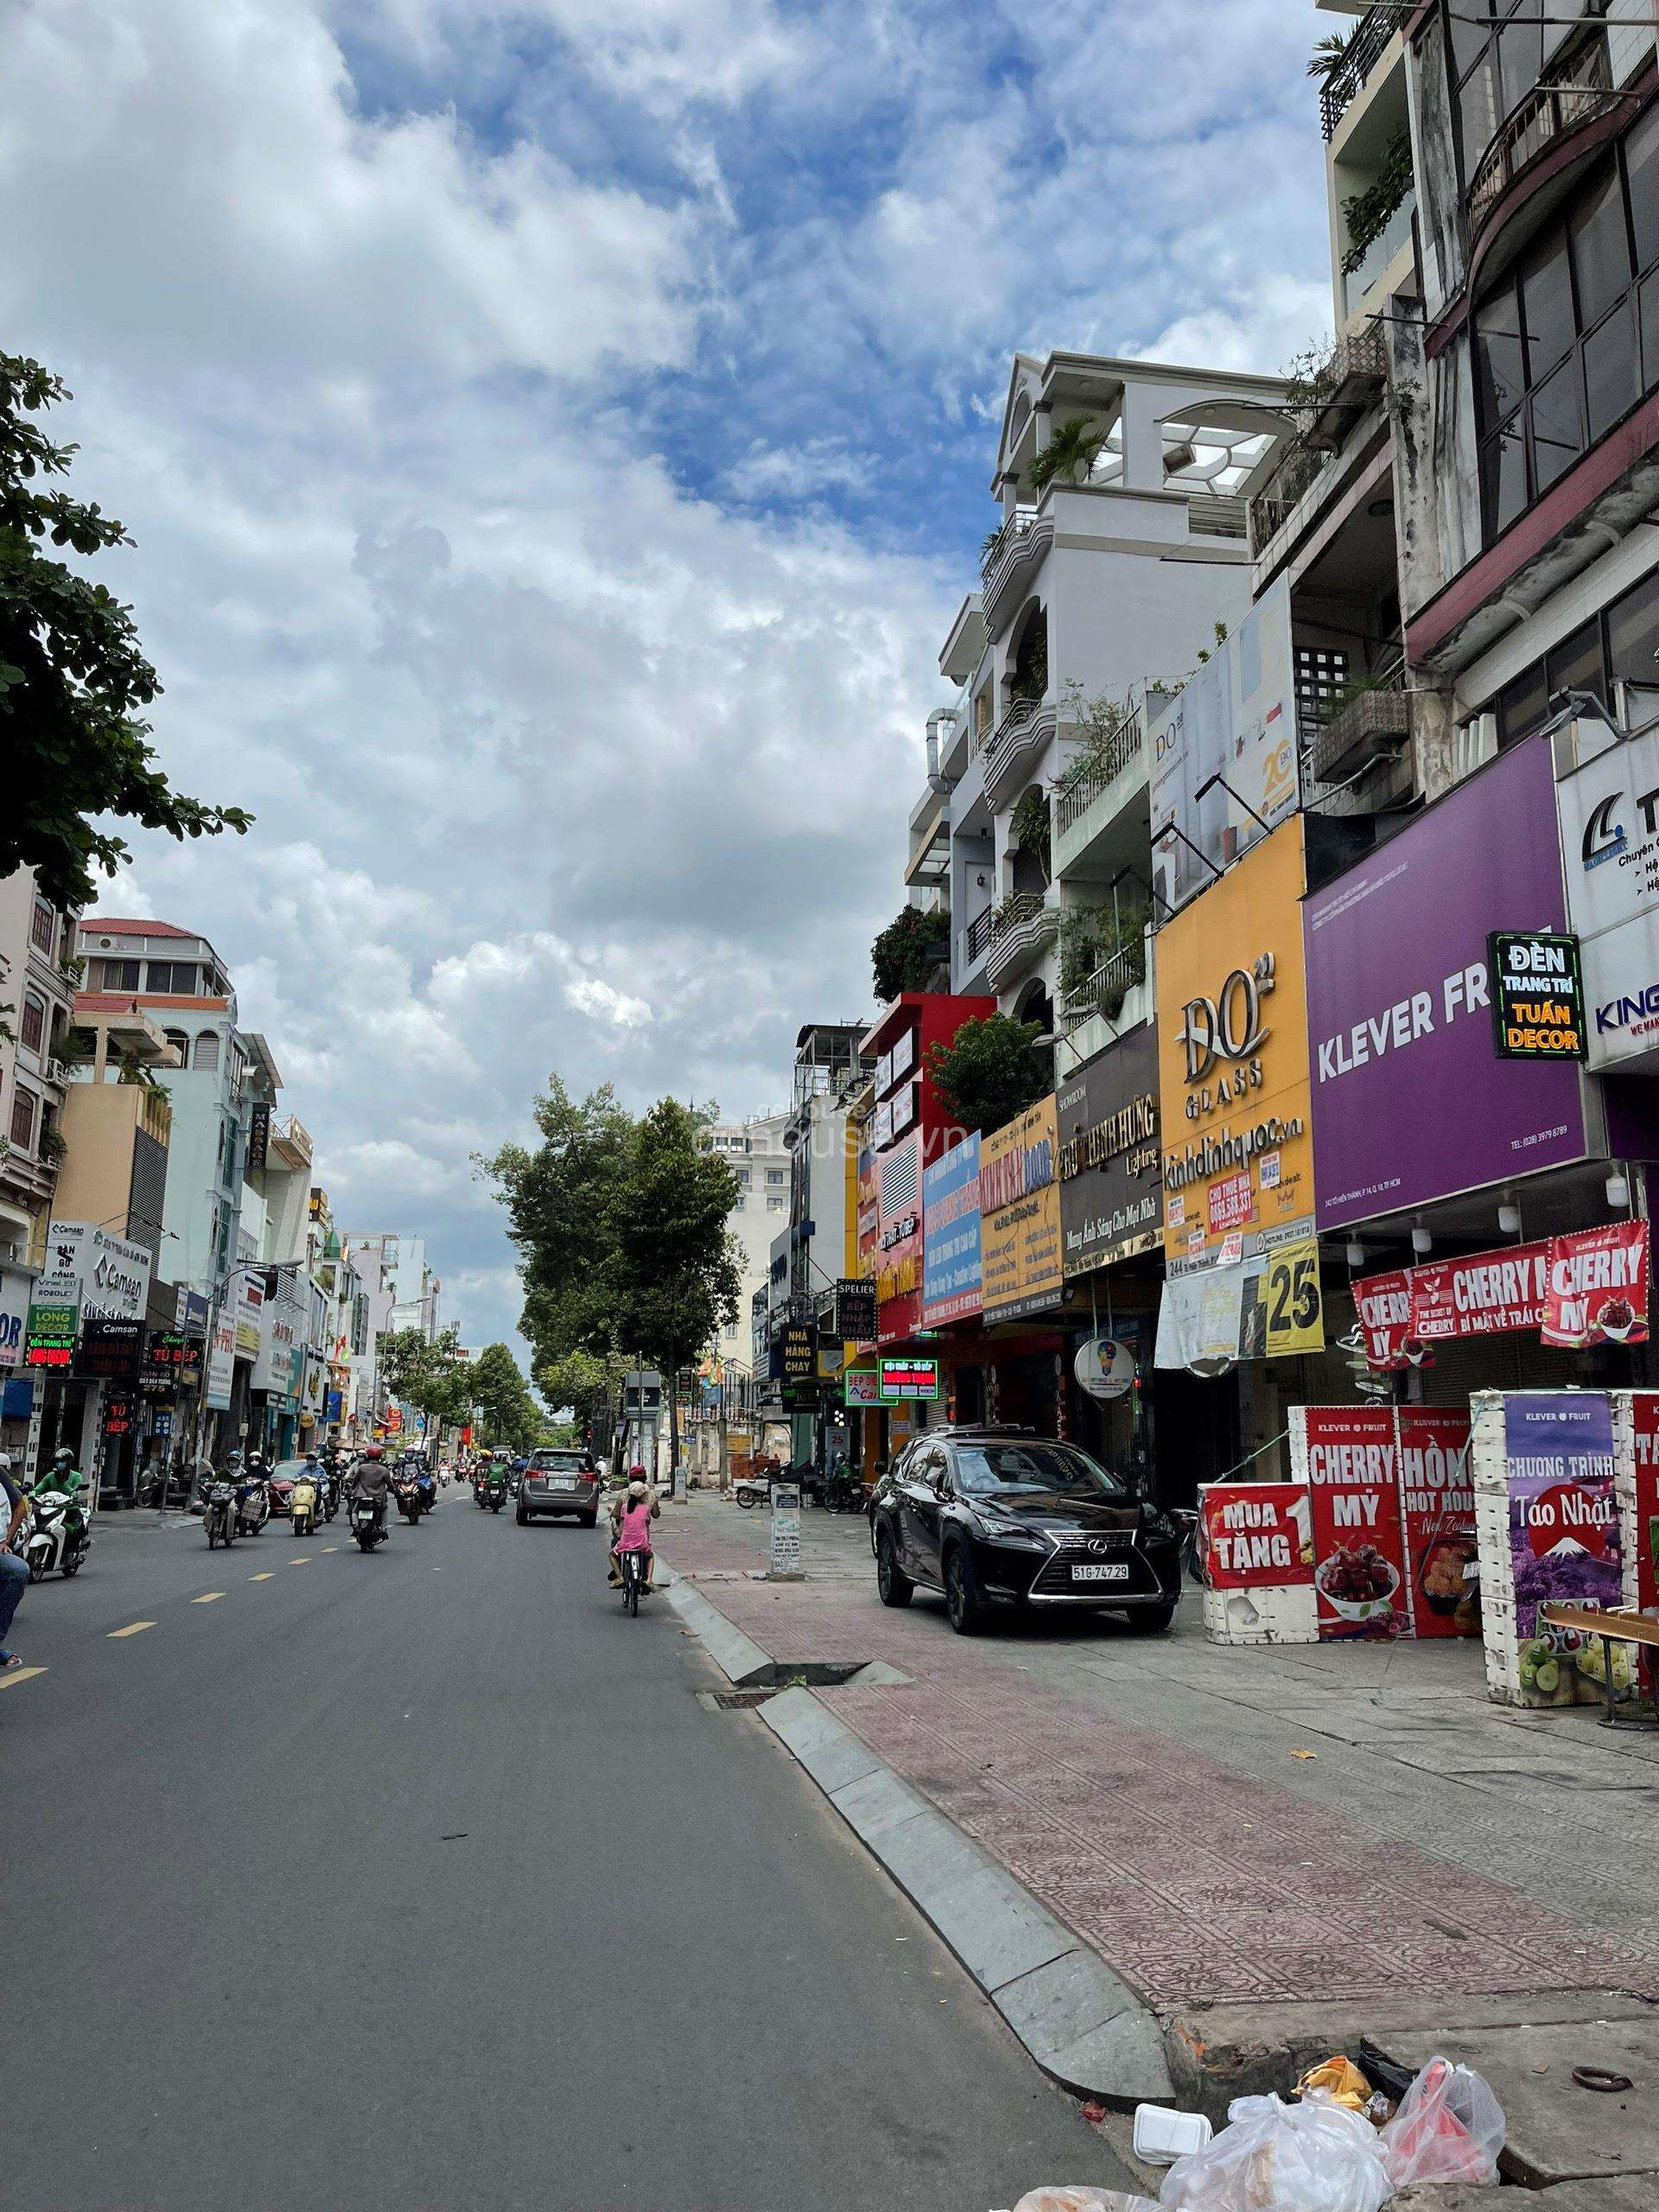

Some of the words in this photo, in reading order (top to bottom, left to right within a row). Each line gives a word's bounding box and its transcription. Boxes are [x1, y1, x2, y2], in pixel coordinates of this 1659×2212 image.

[1618, 842, 1655, 868] Chuyên
[1508, 941, 1566, 973] ĐÈN
[1503, 976, 1551, 993] TRANG
[1552, 976, 1573, 994] TRÍ
[1512, 1000, 1571, 1026] TUẤN
[1318, 990, 1436, 1084] KLEVER
[1508, 1028, 1580, 1050] DECOR
[1058, 1084, 1086, 1113] SHOWROOM
[1185, 1058, 1262, 1120] GLASS
[1126, 1148, 1158, 1180] Lighting
[1163, 1116, 1303, 1192] kinhdinhquoc.vn
[60, 1225, 84, 1235] Camsan
[106, 1263, 142, 1298] Camsan
[1169, 1259, 1184, 1277] 244
[1552, 1243, 1644, 1296] CHERRY
[838, 1284, 874, 1294] SPELIER
[1453, 1258, 1531, 1313] CHERRY
[35, 1323, 69, 1332] DECOR
[36, 1313, 70, 1322] LONG
[103, 1325, 137, 1333] Camsan
[1418, 1319, 1454, 1334] CHERRY
[1460, 1312, 1471, 1332] BÍ
[1510, 1305, 1533, 1326] TRÁI
[788, 1329, 807, 1342] NHÀ
[785, 1344, 811, 1357] HÀNG
[785, 1361, 810, 1372] CHAY
[106, 1418, 129, 1433] BẾP
[1318, 1423, 1351, 1432] KLEVER
[1526, 1413, 1556, 1421] KLEVER
[1568, 1412, 1591, 1421] FRUIT
[1310, 1444, 1395, 1485] CHERRY
[1568, 1452, 1613, 1477] TRÌNH
[1332, 1488, 1380, 1527] MỸ
[1406, 1491, 1436, 1512] HOT
[1441, 1491, 1475, 1512] HOU
[1515, 1493, 1555, 1528] Táo
[1559, 1493, 1613, 1532] Nhật
[1223, 1502, 1279, 1529] MUA
[1286, 1496, 1313, 1547] 1
[1214, 1530, 1292, 1575] TẶNG
